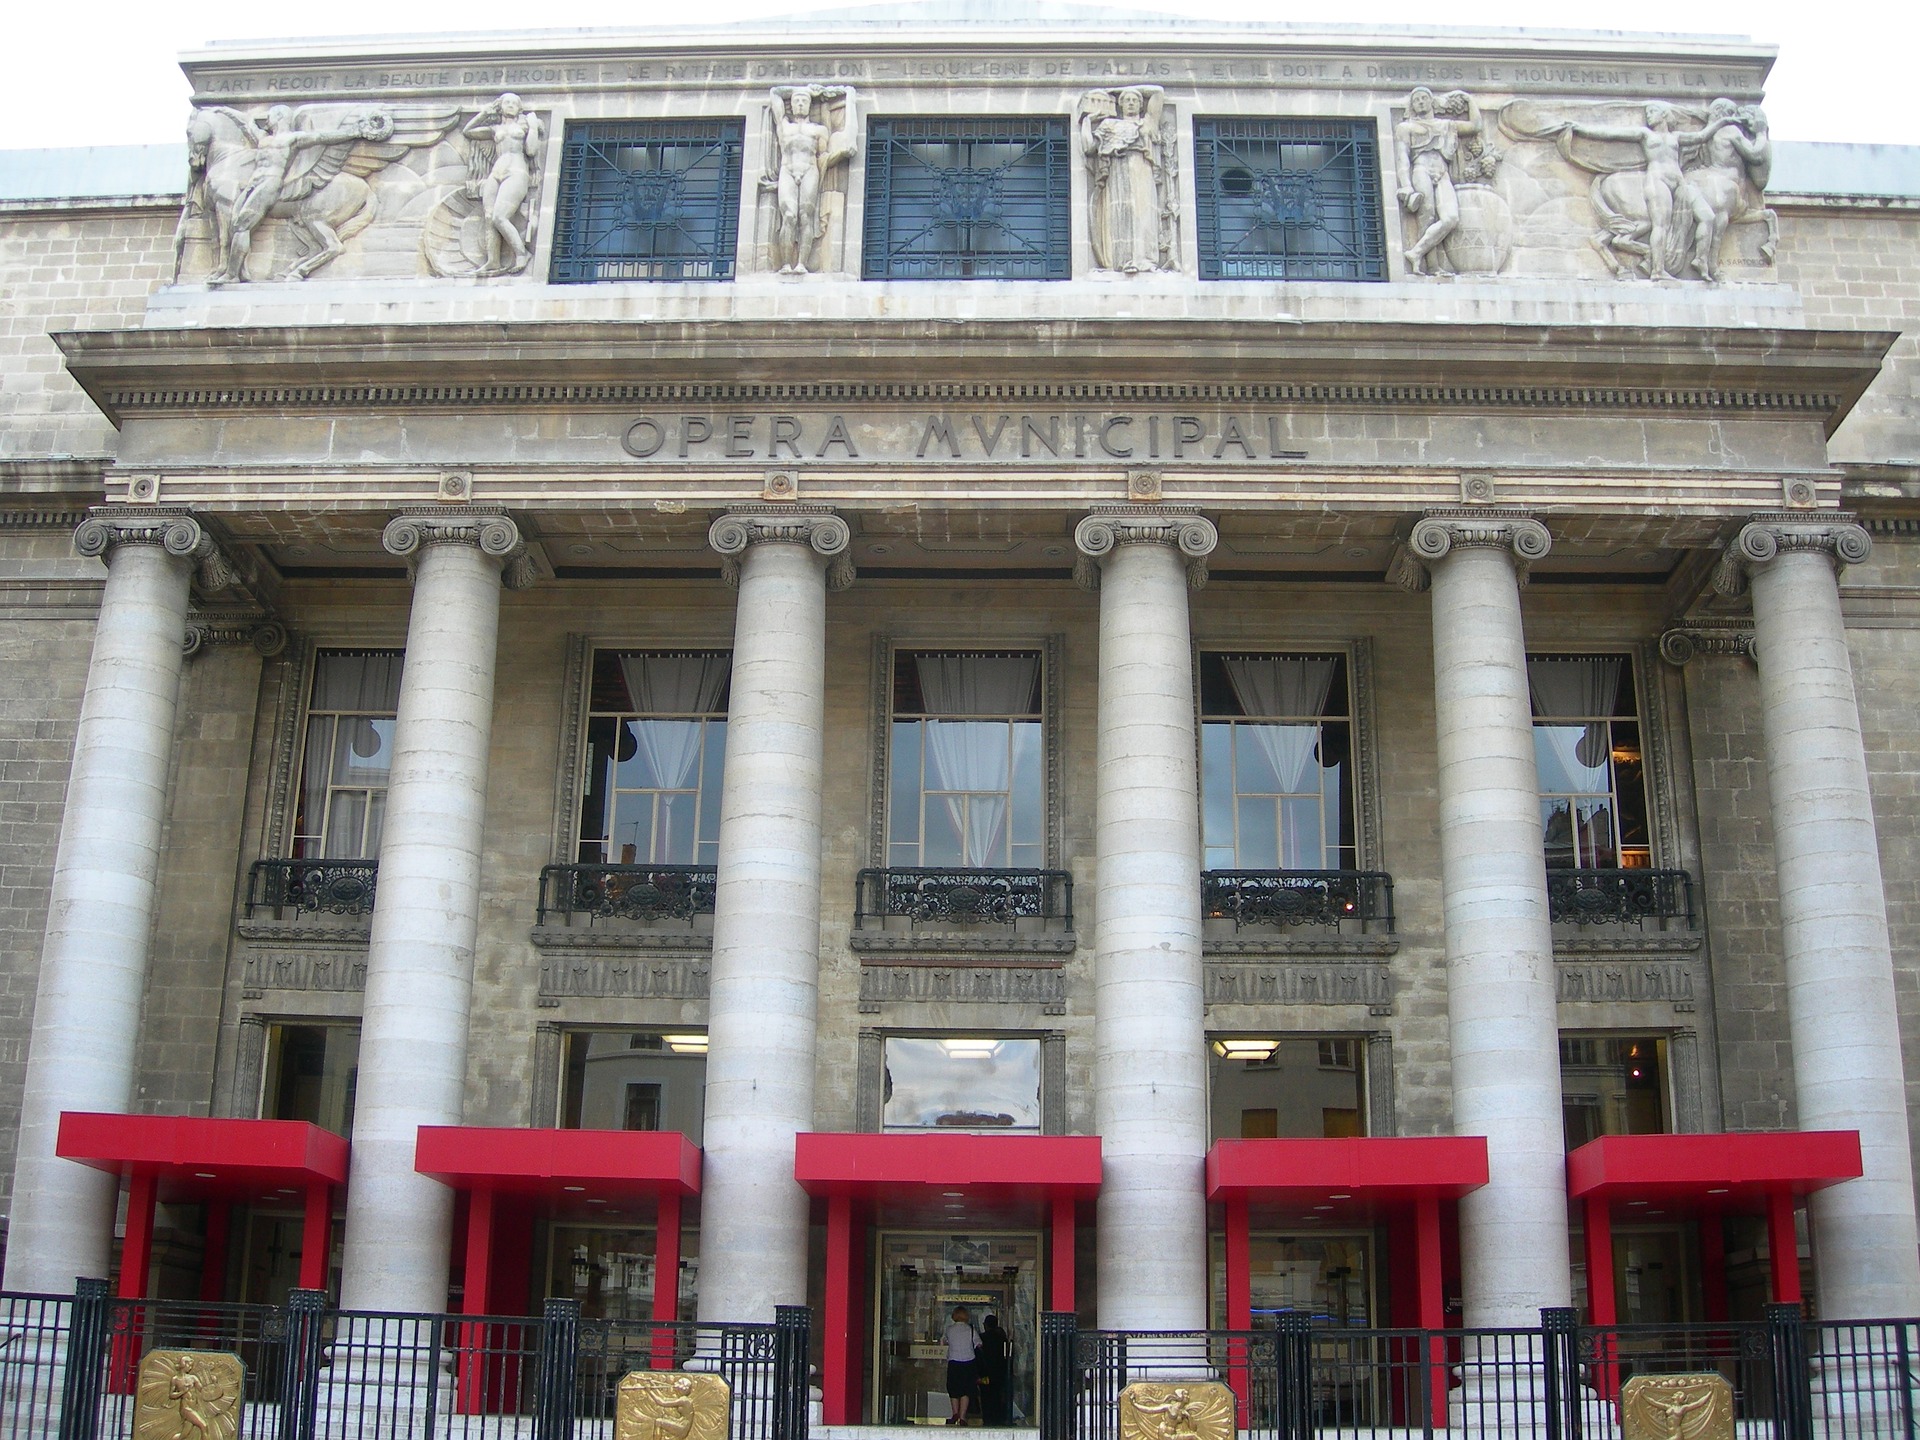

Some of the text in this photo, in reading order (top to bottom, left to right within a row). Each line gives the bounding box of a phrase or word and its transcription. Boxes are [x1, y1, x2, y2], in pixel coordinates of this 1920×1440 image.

[206, 79, 255, 92] L'ART
[343, 75, 366, 88] LA
[379, 72, 450, 86] BEAUTE
[463, 68, 588, 84] D'APHRODITE
[627, 66, 650, 79] LE
[664, 65, 747, 78] RYTHME
[757, 63, 864, 77] D'APOLLON
[1045, 62, 1072, 75] DE
[1086, 62, 1171, 75] PALLAS
[1212, 64, 1236, 76] ET
[1251, 64, 1268, 77] IL
[1283, 64, 1327, 77] DOIT
[1342, 65, 1352, 78] A
[1366, 65, 1464, 80] DIONYSOS
[1478, 67, 1501, 81] LE
[1515, 68, 1632, 84] MOUVEMENT
[1645, 72, 1669, 85] ET
[1683, 73, 1707, 86] LA
[1719, 74, 1750, 88] VIE
[621, 415, 1308, 459] OPERA MVNICIPAL
[921, 1348, 944, 1356] TIREZ
